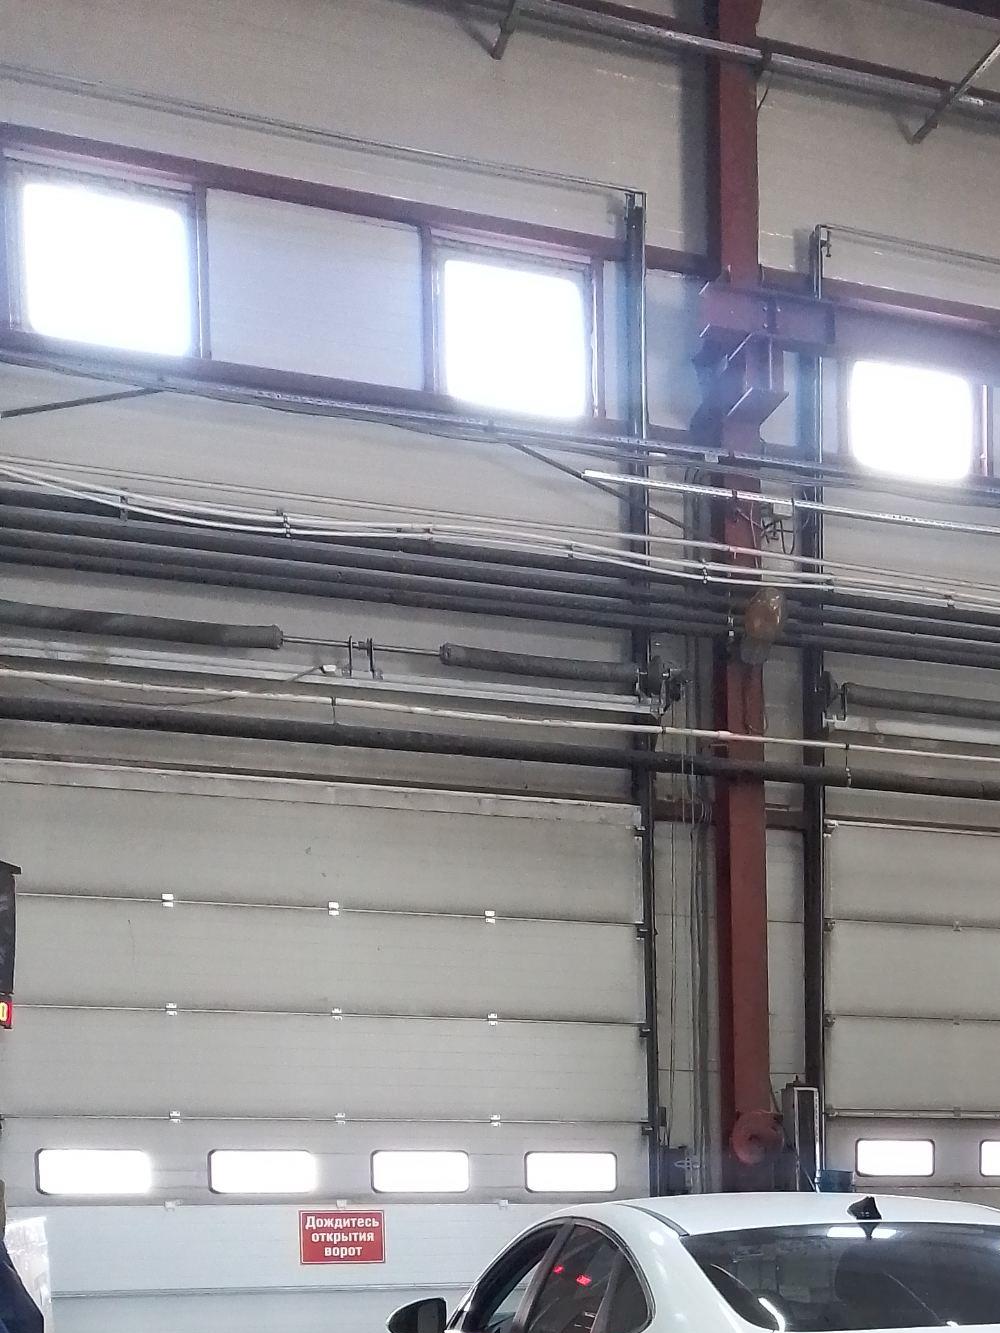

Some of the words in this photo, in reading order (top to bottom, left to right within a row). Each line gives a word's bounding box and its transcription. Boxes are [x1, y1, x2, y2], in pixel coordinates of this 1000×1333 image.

[305, 1215, 379, 1230] Дождитесь
[311, 1232, 374, 1244] открытия
[324, 1246, 362, 1259] ворот
